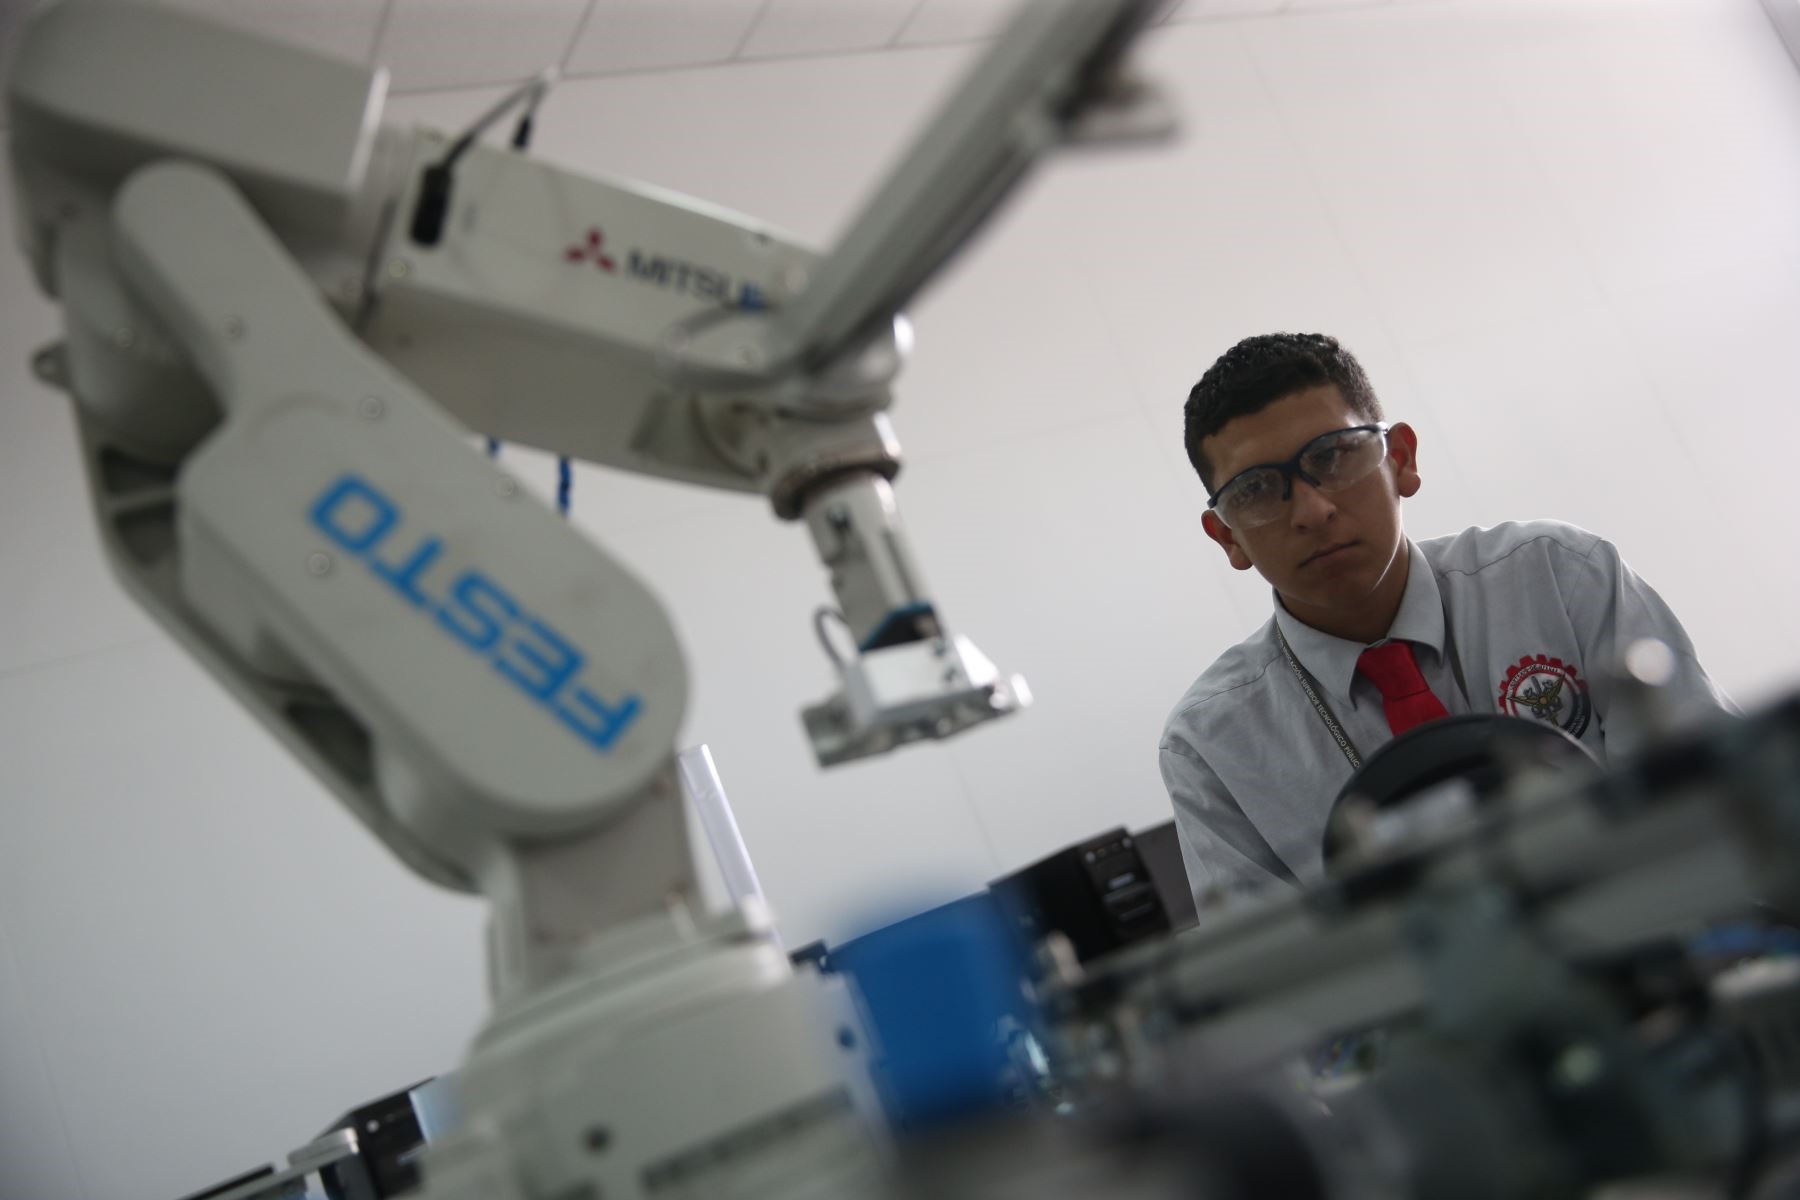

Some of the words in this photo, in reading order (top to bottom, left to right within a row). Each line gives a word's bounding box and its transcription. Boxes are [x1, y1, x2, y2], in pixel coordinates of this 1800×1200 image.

[309, 473, 644, 754] FESTO
[1316, 704, 1347, 747] TECNOLÓGICO
[1344, 745, 1361, 769] PÚBLIC
